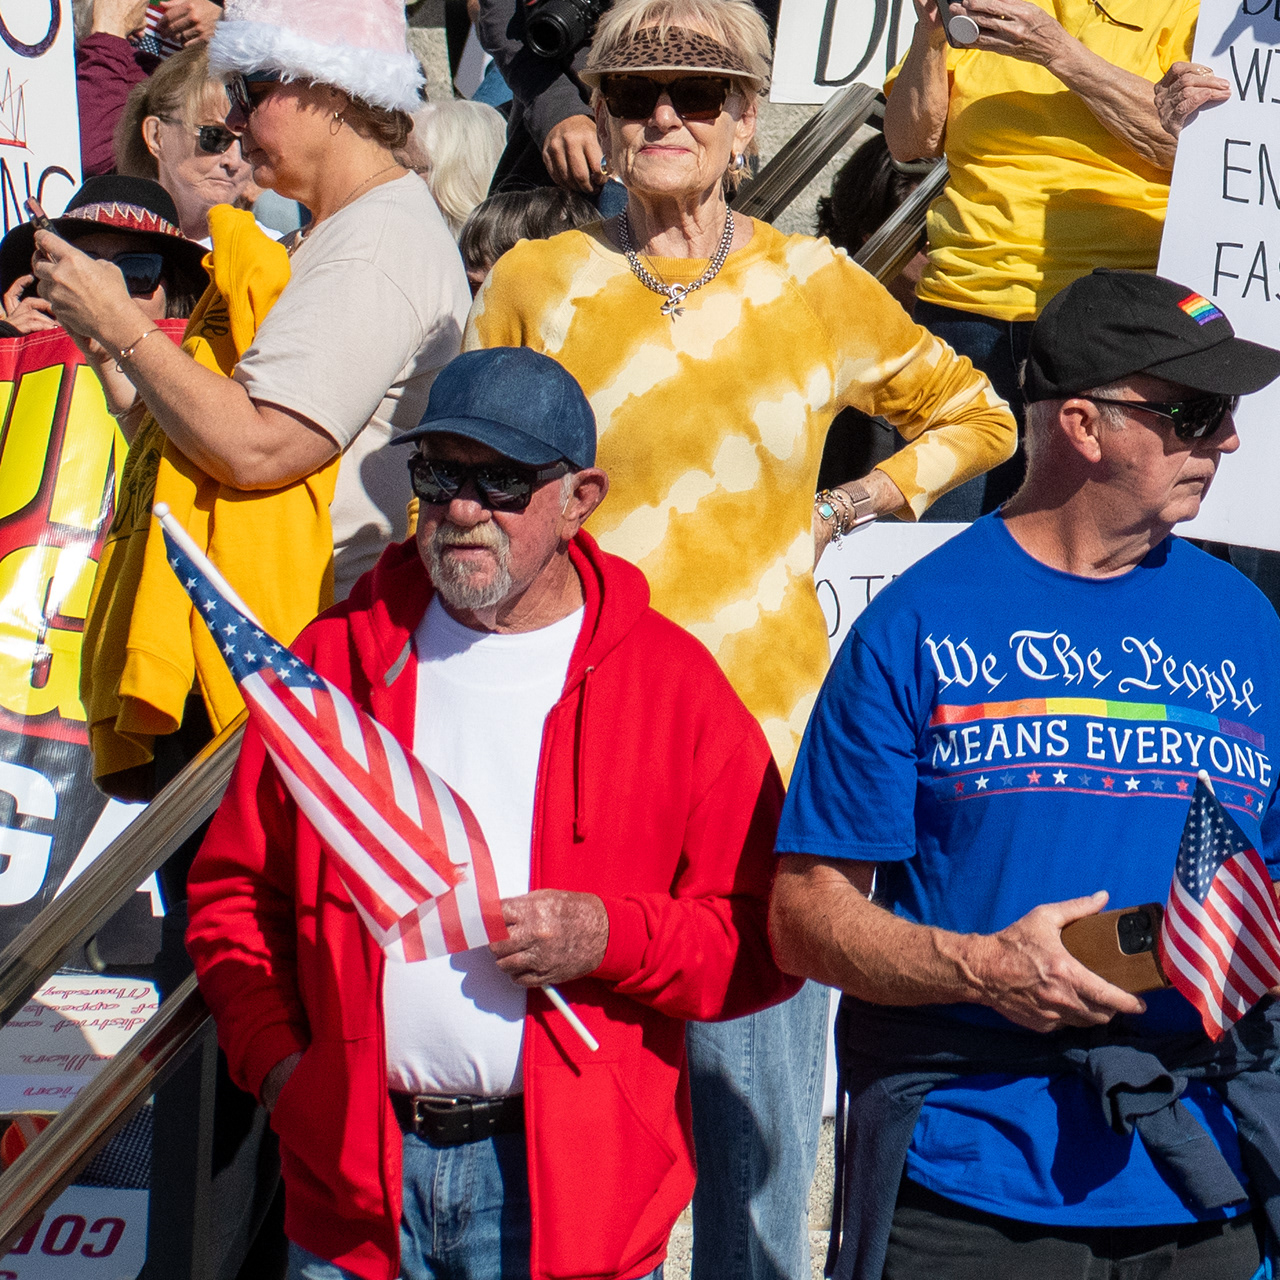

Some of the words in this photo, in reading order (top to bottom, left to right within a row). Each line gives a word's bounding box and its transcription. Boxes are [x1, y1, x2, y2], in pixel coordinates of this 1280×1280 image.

[920, 631, 1009, 695] We
[1008, 628, 1114, 690] The
[1117, 634, 1264, 718] People
[932, 719, 1069, 770] MEANS
[1086, 721, 1273, 789] EVERYONE
